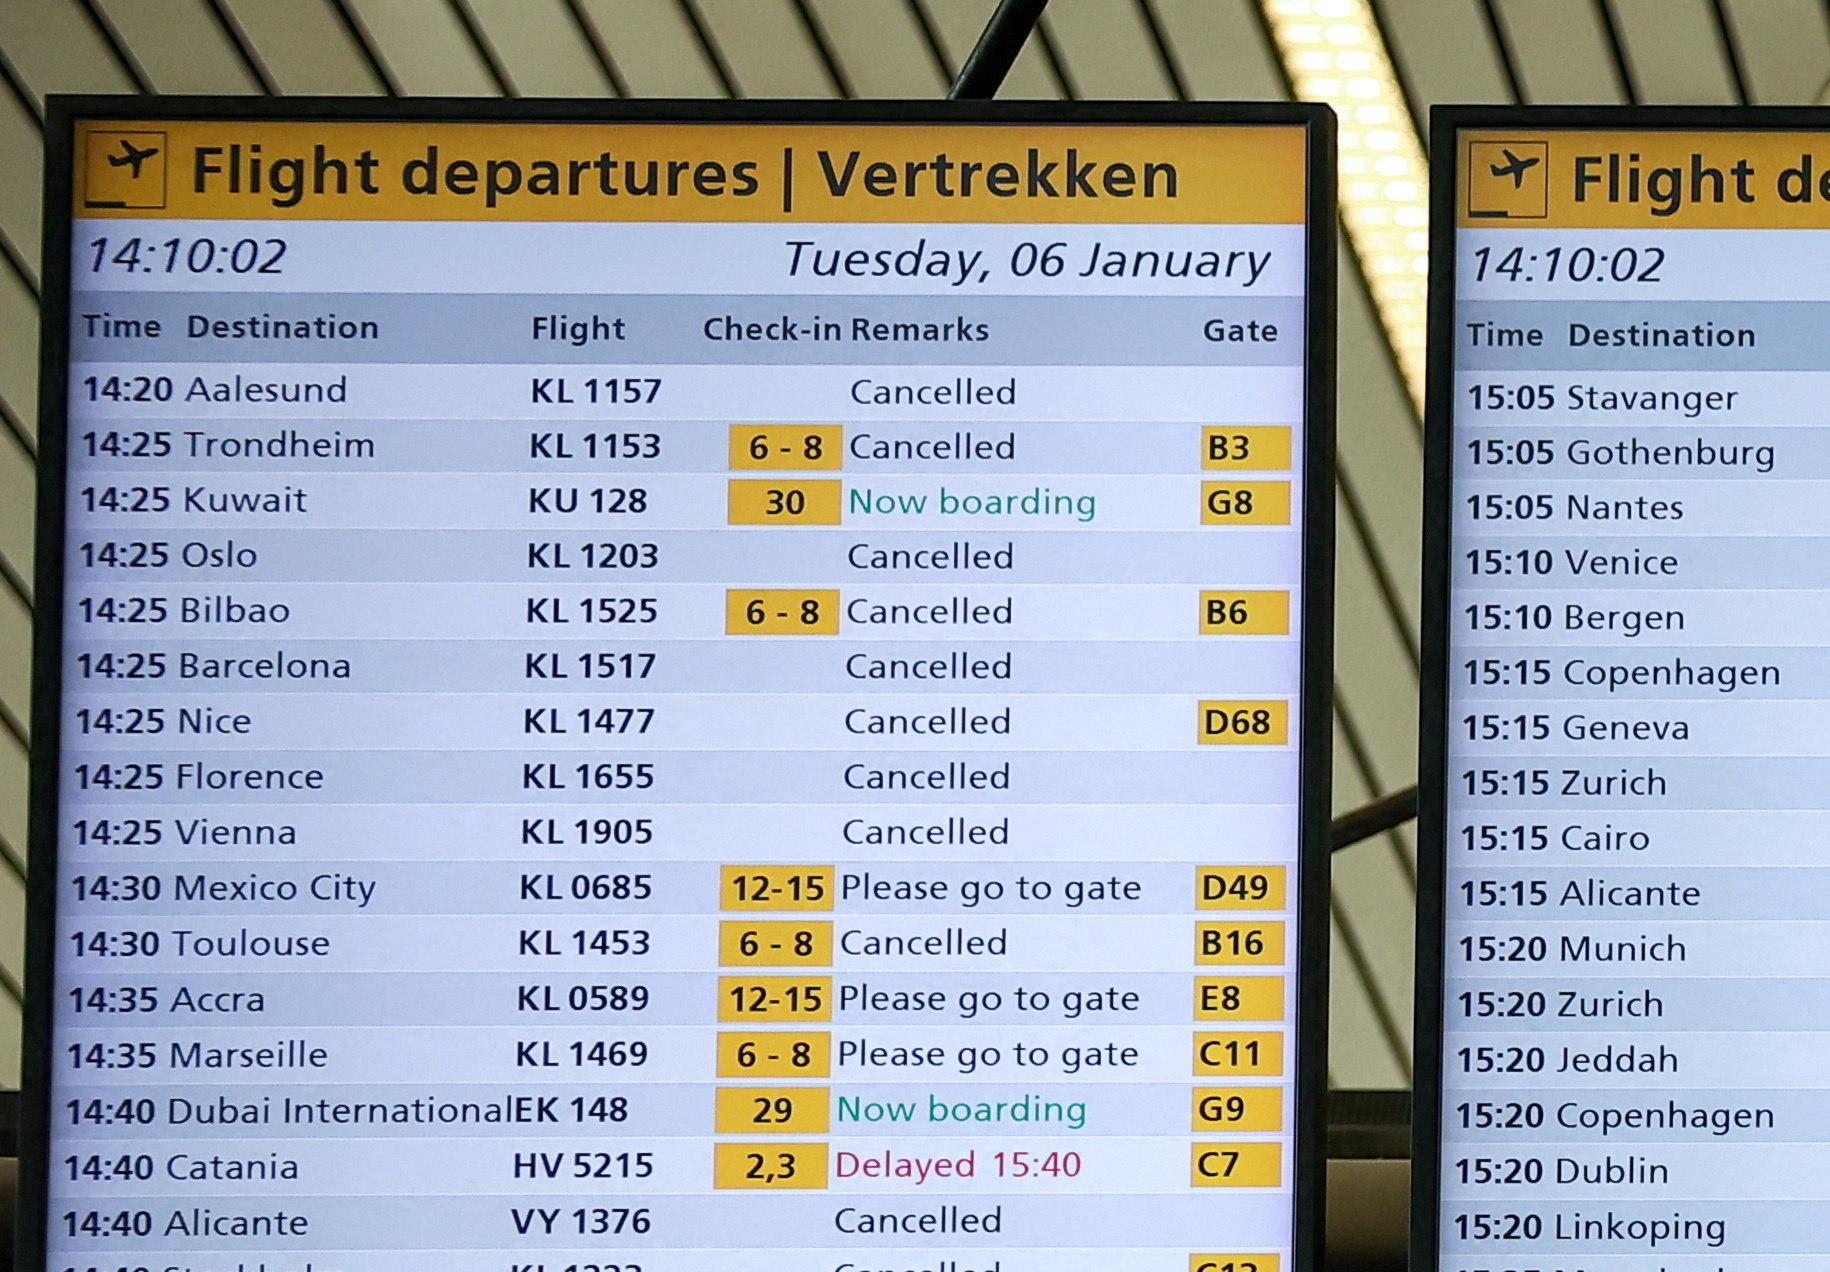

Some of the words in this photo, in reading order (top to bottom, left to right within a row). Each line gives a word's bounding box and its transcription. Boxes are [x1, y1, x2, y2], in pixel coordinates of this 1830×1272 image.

[192, 142, 381, 210] Flight
[401, 144, 760, 210] departures
[816, 146, 1178, 199] Vertrekken
[1573, 152, 1757, 219] Flight
[89, 236, 288, 276] 14:10:02
[784, 237, 991, 288] Tuesday,
[1009, 240, 1069, 279] 06
[1077, 240, 1273, 289] January
[1473, 245, 1667, 284] 14:10:02
[81, 313, 162, 339] Time
[186, 312, 379, 340] Destination
[531, 313, 627, 348] Flight
[702, 313, 843, 343] Check-in
[850, 314, 991, 343] Remarks
[1202, 317, 1279, 344] Gate
[1467, 383, 1556, 412] 15:05
[1566, 383, 1740, 420] Stavanger
[80, 485, 171, 514] 14:25
[183, 484, 308, 514] Kuwait
[528, 486, 579, 515] KU
[588, 486, 649, 515] 128
[764, 488, 807, 517] 30
[849, 487, 929, 515] Now
[939, 485, 1096, 524] boarding
[1206, 488, 1254, 517] G8
[1461, 768, 1551, 797] 15:15
[1559, 766, 1667, 797] Zurich
[1456, 1045, 1546, 1074] 15:20
[1555, 1043, 1679, 1074] Jeddah
[63, 1153, 155, 1182] 14:40
[165, 1151, 299, 1182] Catania
[512, 1151, 566, 1180] HV
[572, 1150, 654, 1180] 5215
[744, 1151, 797, 1185] 2,3
[835, 1148, 976, 1187] Delayed
[993, 1150, 1082, 1179] 15:40
[1196, 1150, 1241, 1179] C7
